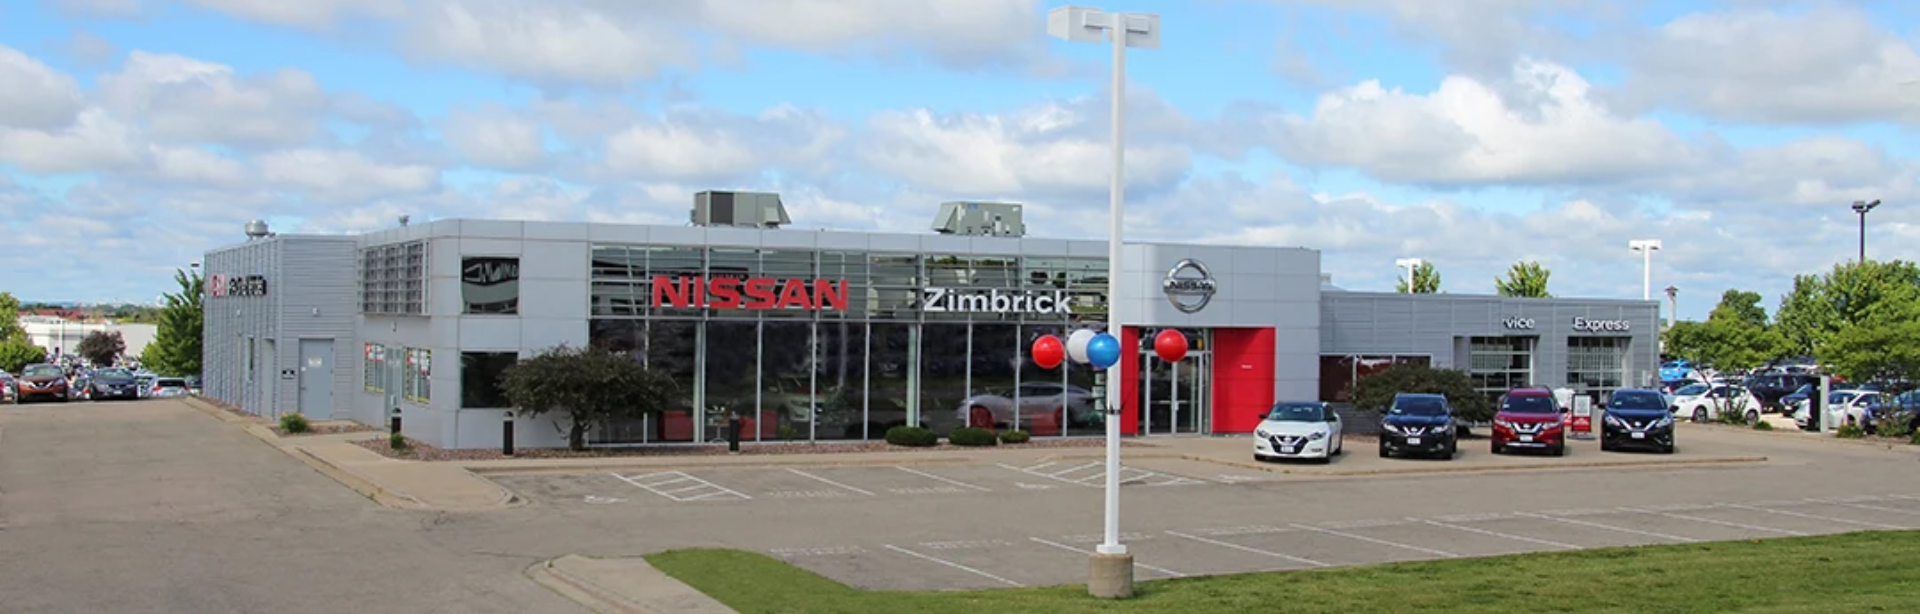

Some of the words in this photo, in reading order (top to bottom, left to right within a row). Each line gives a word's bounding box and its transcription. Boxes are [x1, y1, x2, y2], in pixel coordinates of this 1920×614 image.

[652, 275, 849, 310] NISSAN
[923, 287, 1073, 314] Zimbrick
[1573, 316, 1630, 332] Express
